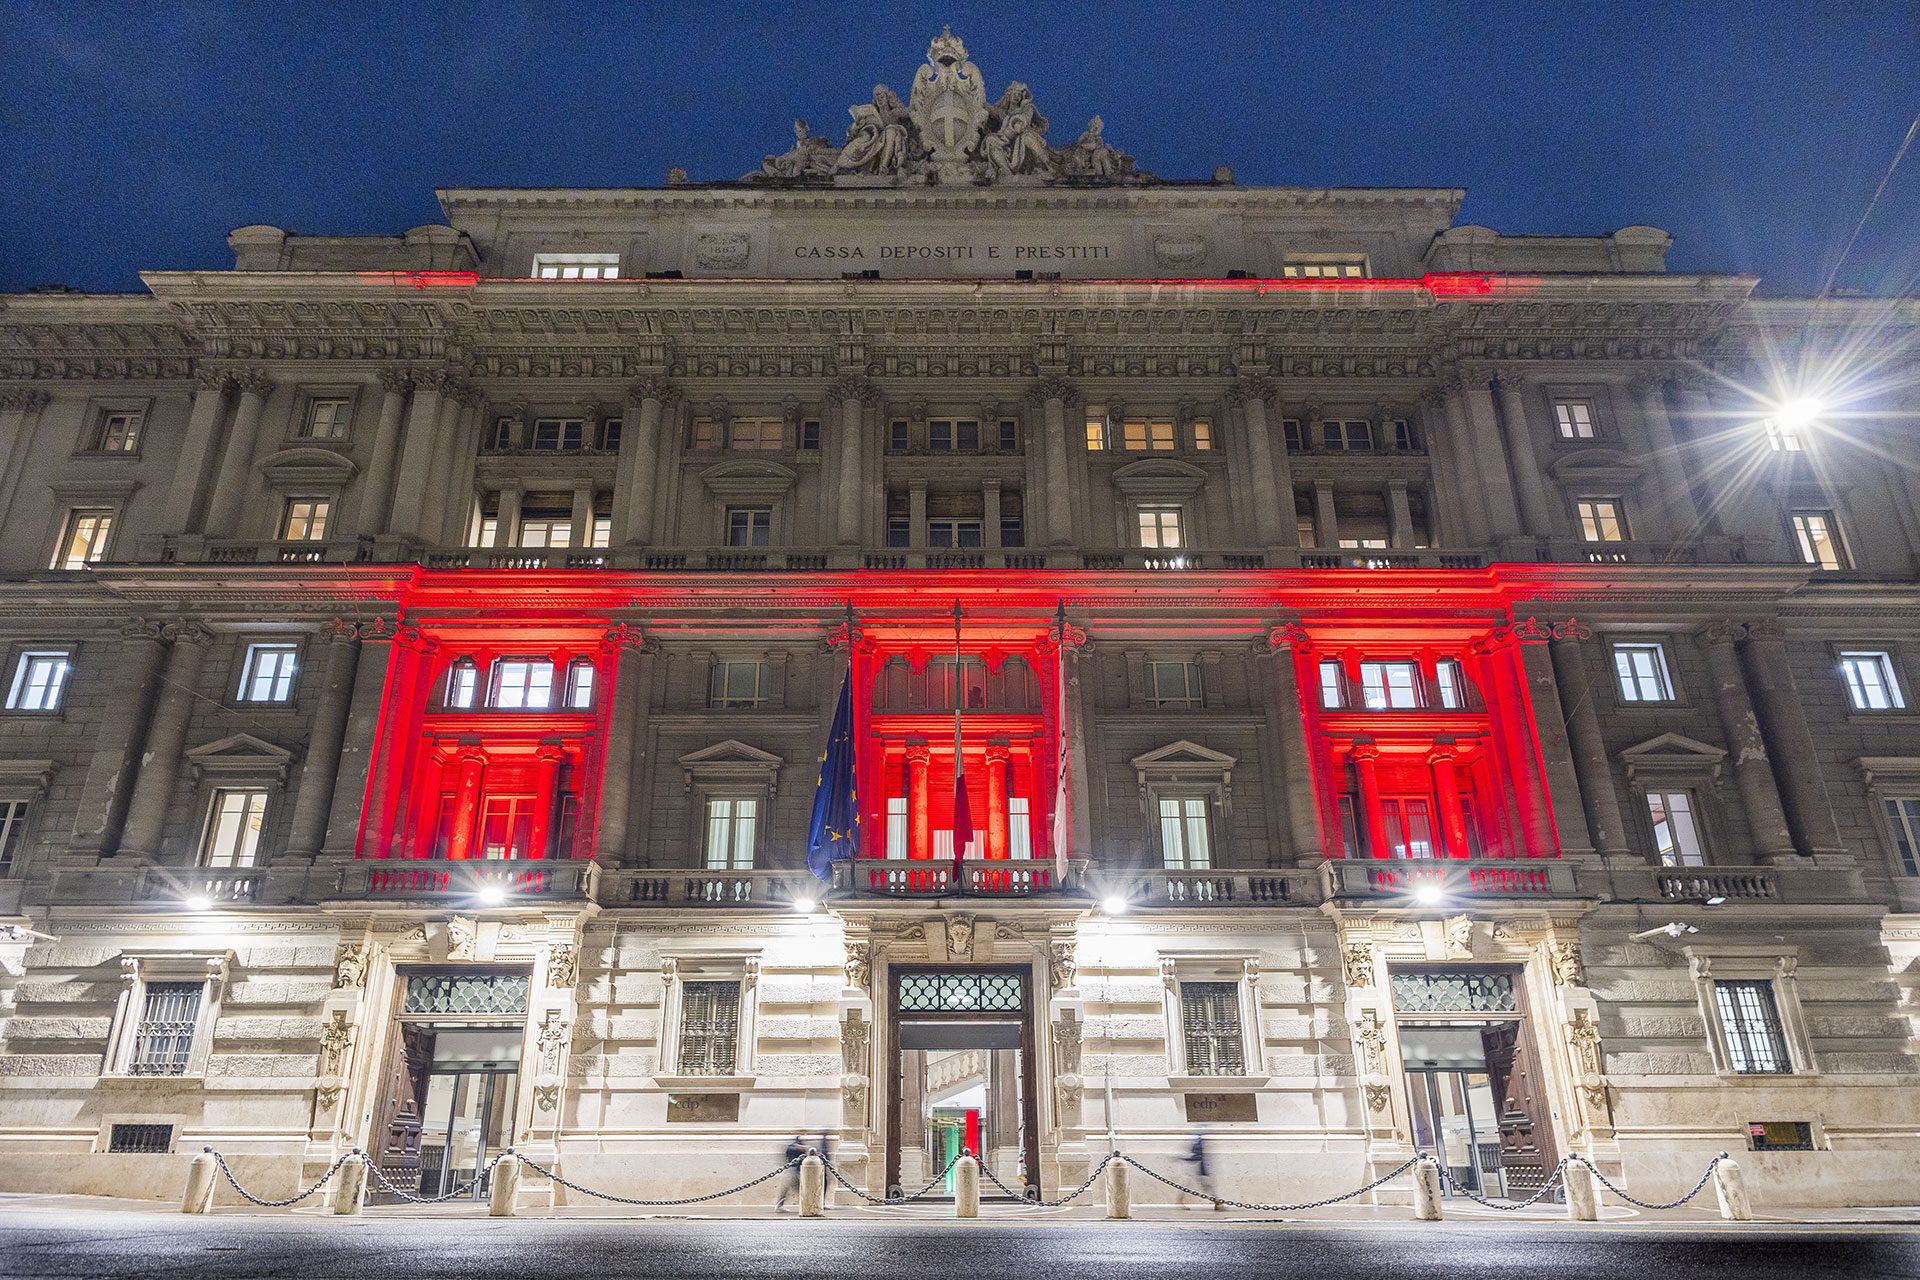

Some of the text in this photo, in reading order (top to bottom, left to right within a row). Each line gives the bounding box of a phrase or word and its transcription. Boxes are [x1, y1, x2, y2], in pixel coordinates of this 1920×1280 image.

[795, 246, 1109, 259] CASSA DEPOSITI E PRESTITI
[675, 1098, 699, 1111] cdp
[1192, 1097, 1217, 1112] cdp
